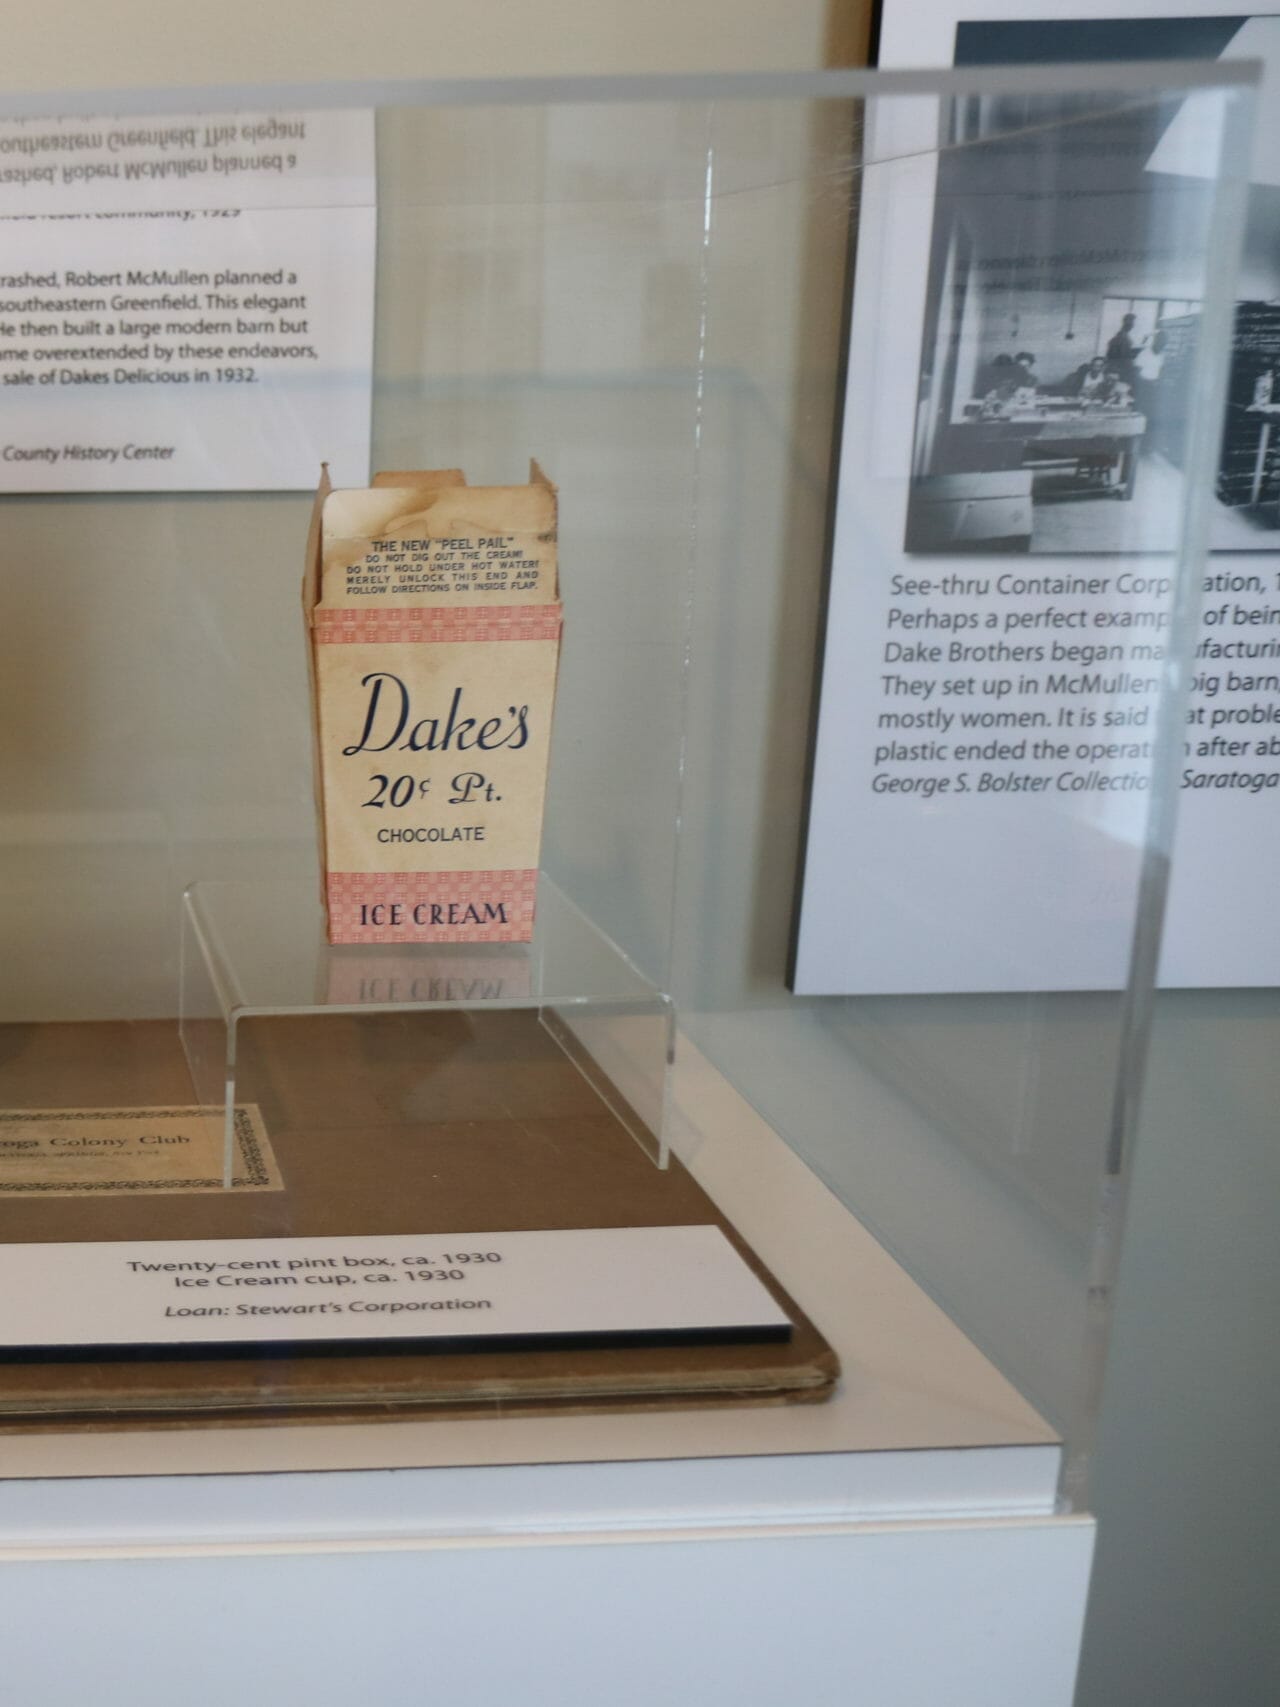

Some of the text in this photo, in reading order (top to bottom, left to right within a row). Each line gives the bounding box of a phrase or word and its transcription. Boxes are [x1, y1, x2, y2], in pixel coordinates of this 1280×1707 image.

[66, 272, 121, 287] Robert
[127, 271, 209, 286] McMullen
[215, 270, 283, 288] planned
[288, 273, 297, 285] a
[111, 295, 202, 311] Greenfield.
[205, 294, 238, 310] This
[243, 294, 306, 313] elegant
[20, 321, 58, 337] then
[64, 321, 100, 336] built
[106, 324, 115, 336] a
[120, 320, 161, 339] large
[166, 320, 232, 335] modern
[237, 319, 275, 334] barn
[279, 318, 308, 334] but
[33, 344, 150, 361] overextended
[154, 344, 173, 363] by
[178, 344, 223, 359] these
[228, 343, 318, 361] endeavors,
[3, 370, 33, 385] sale
[39, 369, 57, 384] of
[60, 368, 109, 384] Dakes
[114, 368, 189, 384] Delicious
[194, 368, 210, 383] in
[216, 367, 259, 383] 1932.
[3, 446, 60, 464] County
[63, 444, 118, 463] History
[123, 444, 175, 460] Center
[372, 540, 397, 552] THE
[401, 540, 430, 551] NEW
[365, 554, 380, 563] DO
[386, 553, 406, 562] NOT
[411, 553, 428, 562] DIG
[434, 552, 455, 561] OUT
[461, 551, 480, 560] THE
[346, 566, 361, 574] DO
[367, 565, 387, 574] NOT
[394, 564, 423, 573] HOLD
[429, 562, 464, 571] UNDER
[471, 561, 492, 570] HOT
[346, 571, 539, 585] MERELY UNLOCK THIS END AND
[890, 575, 989, 597] See-thru
[997, 573, 1110, 596] Container
[1116, 571, 1267, 600] Corpation,
[346, 586, 386, 595] FOLLOW
[392, 584, 449, 593] DIRECTIONS
[456, 583, 469, 592] ON
[474, 582, 506, 591] INSIDE
[887, 608, 979, 631] Perhaps
[984, 614, 999, 629] a
[1004, 606, 1087, 633] perfect
[1203, 604, 1230, 626] of
[884, 642, 942, 664] Dake
[948, 641, 1044, 663] Brothers
[1051, 641, 1124, 666] began
[882, 675, 937, 699] They
[943, 676, 976, 697] set
[983, 679, 1012, 699] up
[1019, 674, 1039, 695] in
[342, 671, 530, 757] Dake's
[878, 709, 952, 732] mostly
[960, 711, 1051, 728] women.
[1058, 708, 1074, 727] It
[1080, 707, 1097, 727] is
[1103, 706, 1148, 727] said
[874, 741, 948, 766] plastic
[954, 740, 1026, 761] ended
[1033, 740, 1069, 761] the
[1196, 736, 1250, 757] after
[448, 771, 502, 804] Pt.
[872, 774, 950, 798] George
[955, 774, 971, 792] S.
[977, 772, 1051, 792] Bolster
[1180, 769, 1280, 793] Saratoga
[377, 825, 484, 843] CHOCOLATE
[360, 902, 508, 926] ICE CREAM
[50, 1136, 128, 1148] Colony
[139, 1134, 190, 1145] Club
[127, 1252, 502, 1273] Twenty-cent pint box, ca. 1930
[175, 1269, 465, 1288] Ice Cream cup, ca. 1930
[165, 1299, 492, 1318] Loan: Stewart's Corporation
